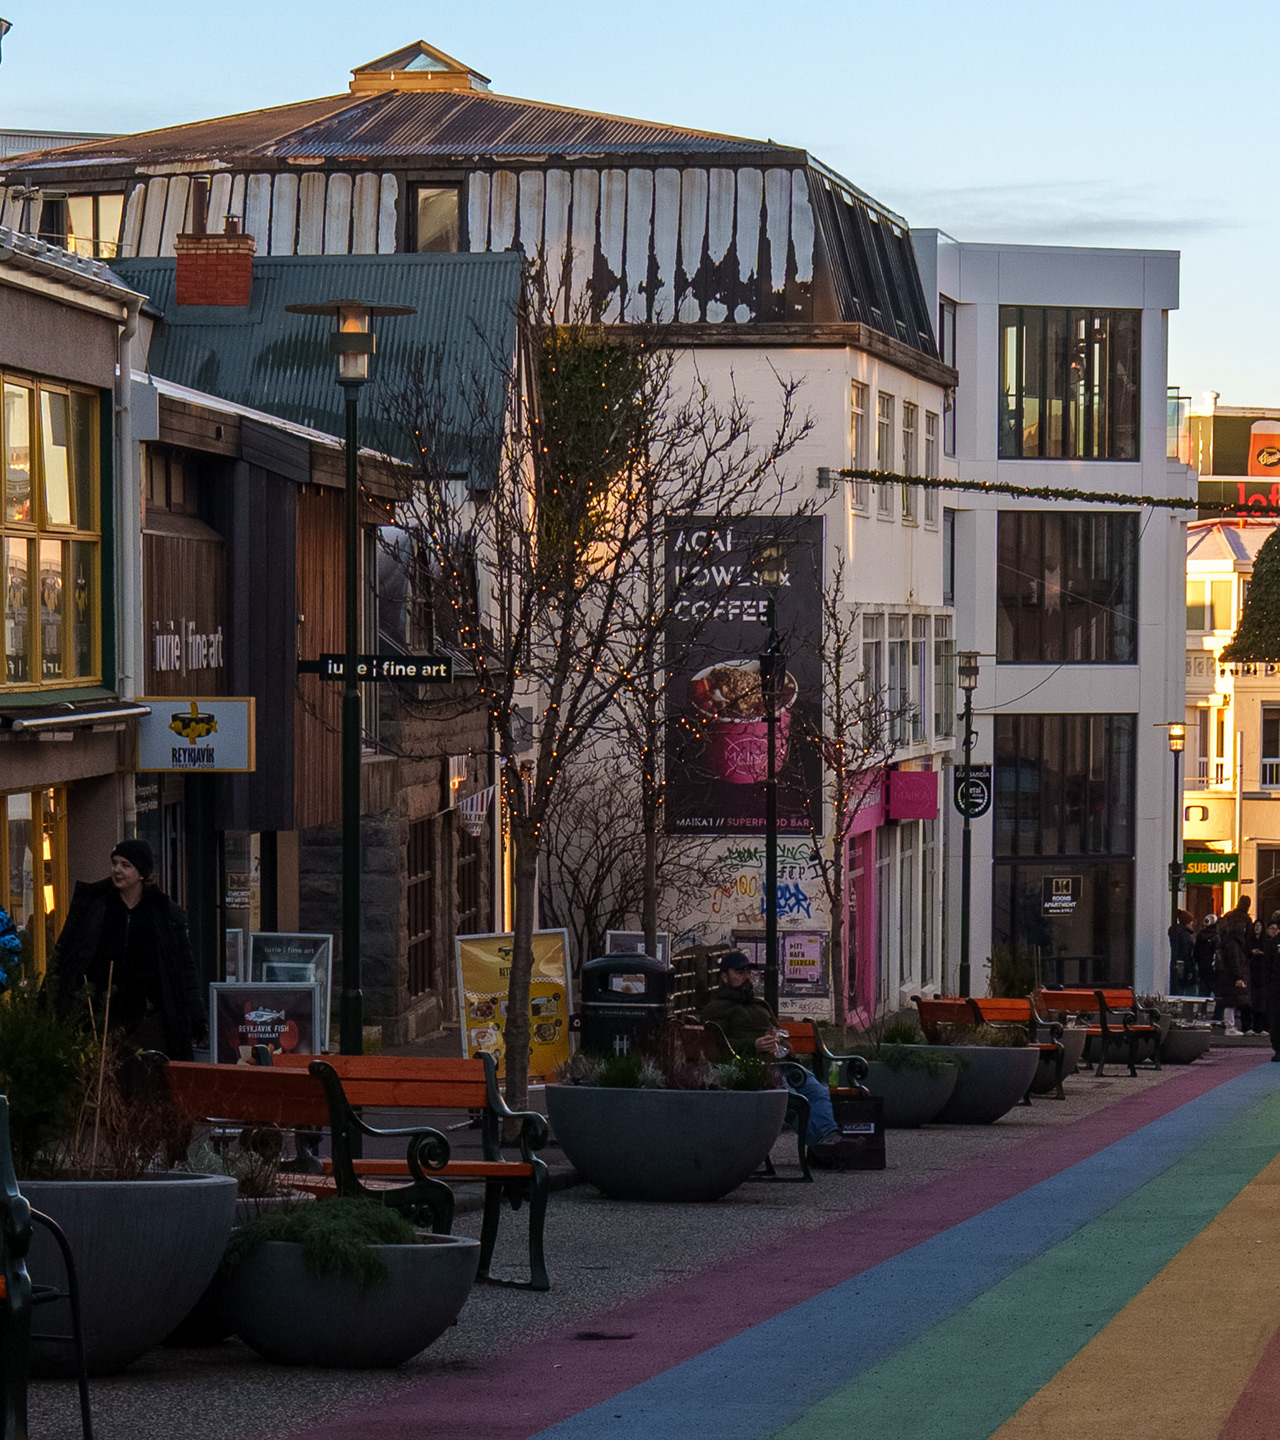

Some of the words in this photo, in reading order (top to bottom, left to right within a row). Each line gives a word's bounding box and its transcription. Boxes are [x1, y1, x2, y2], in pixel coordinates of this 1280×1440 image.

[187, 621, 208, 670] fine
[208, 625, 224, 668] art
[327, 659, 367, 676] iue
[382, 660, 417, 677] fine
[421, 663, 447, 678] art
[171, 743, 215, 766] REYKJAVÍK
[790, 817, 810, 827] BAR
[1185, 861, 1236, 874] SUBWAY
[264, 946, 282, 954] iurie
[287, 946, 303, 954] fine
[238, 1024, 272, 1033] REYKJAVIK
[274, 1024, 290, 1033] FISH
